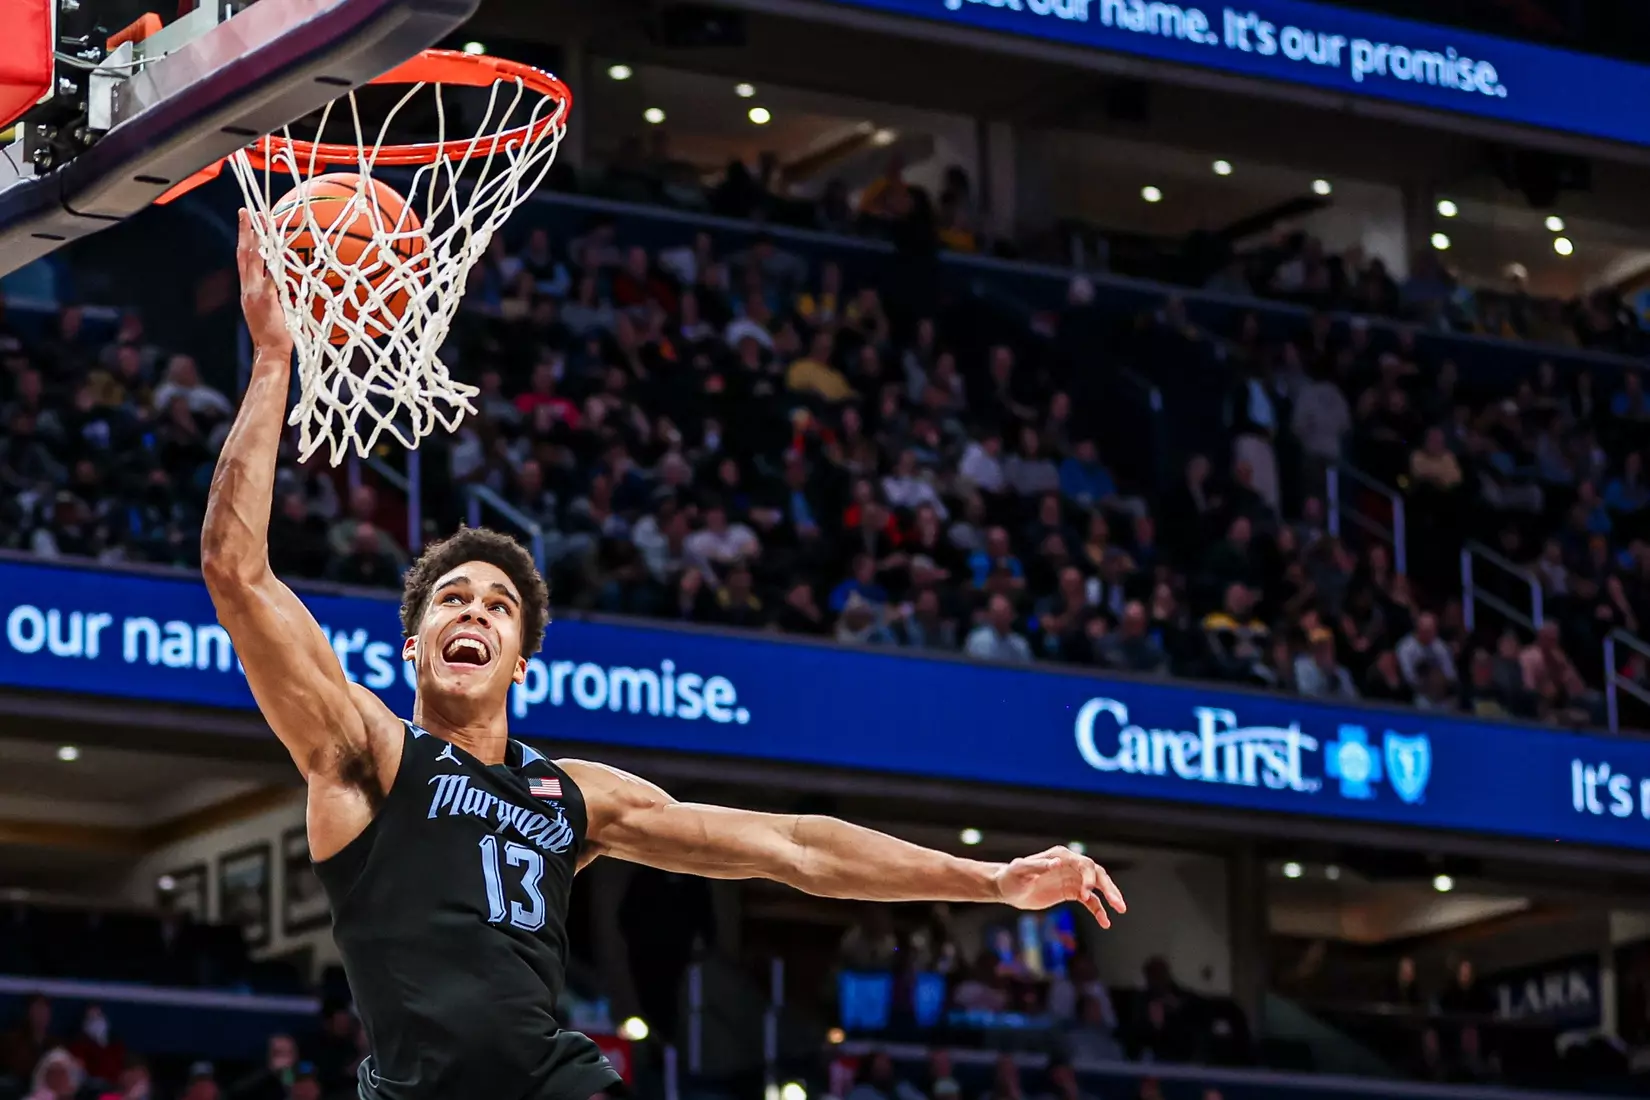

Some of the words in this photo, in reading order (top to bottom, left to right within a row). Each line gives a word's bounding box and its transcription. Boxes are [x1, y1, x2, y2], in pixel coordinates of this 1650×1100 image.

[1101, 0, 1218, 45] name.
[1223, 6, 1277, 56] It's
[1280, 25, 1347, 67] our
[1351, 39, 1507, 98] promise.
[7, 604, 112, 659] our
[123, 616, 246, 674] nam
[320, 624, 395, 689] t's
[512, 657, 750, 724] promise.
[1075, 697, 1319, 792] CareFirst
[1571, 758, 1634, 818] It's
[427, 774, 574, 854] Marquette
[479, 834, 546, 932] 13
